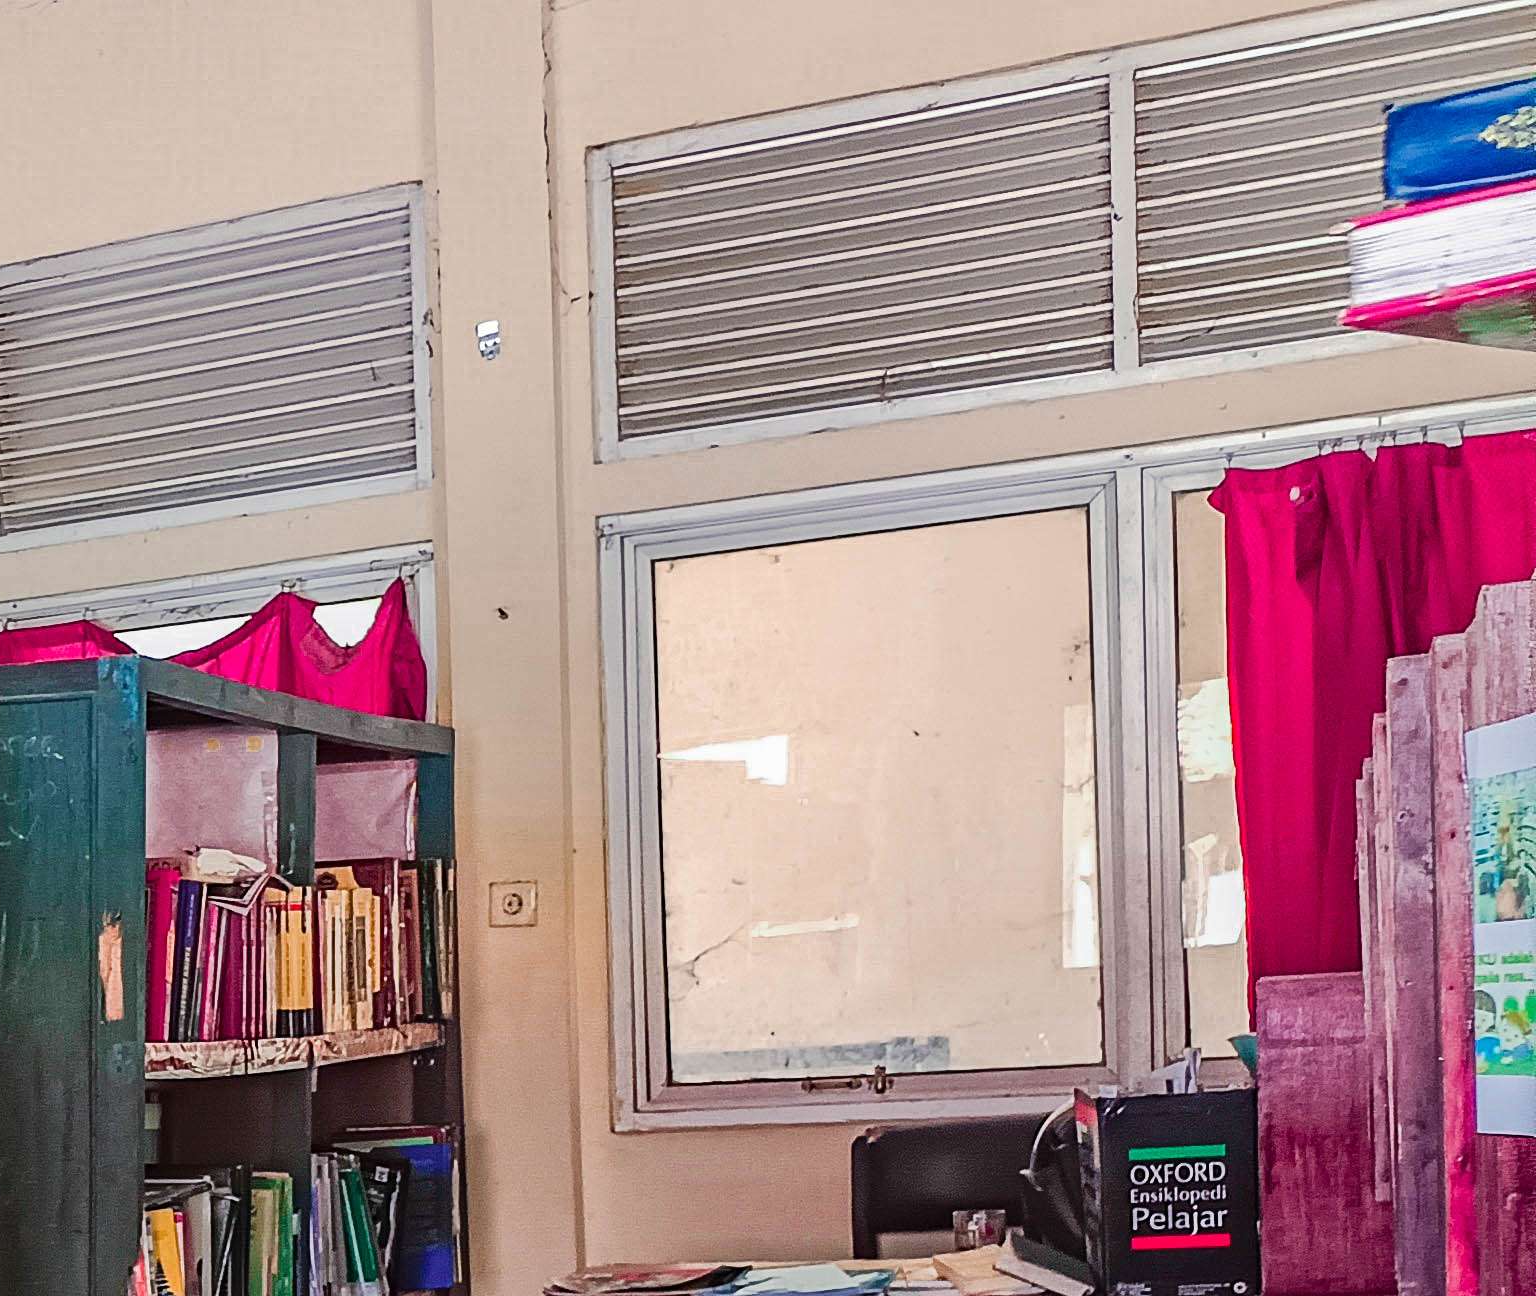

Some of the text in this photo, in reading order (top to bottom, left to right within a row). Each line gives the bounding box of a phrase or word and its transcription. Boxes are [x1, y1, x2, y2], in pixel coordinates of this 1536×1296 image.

[1130, 1161, 1226, 1185] OXFORD
[1130, 1184, 1227, 1205] Ensiklopedi
[1132, 1204, 1228, 1236] Pelajar
